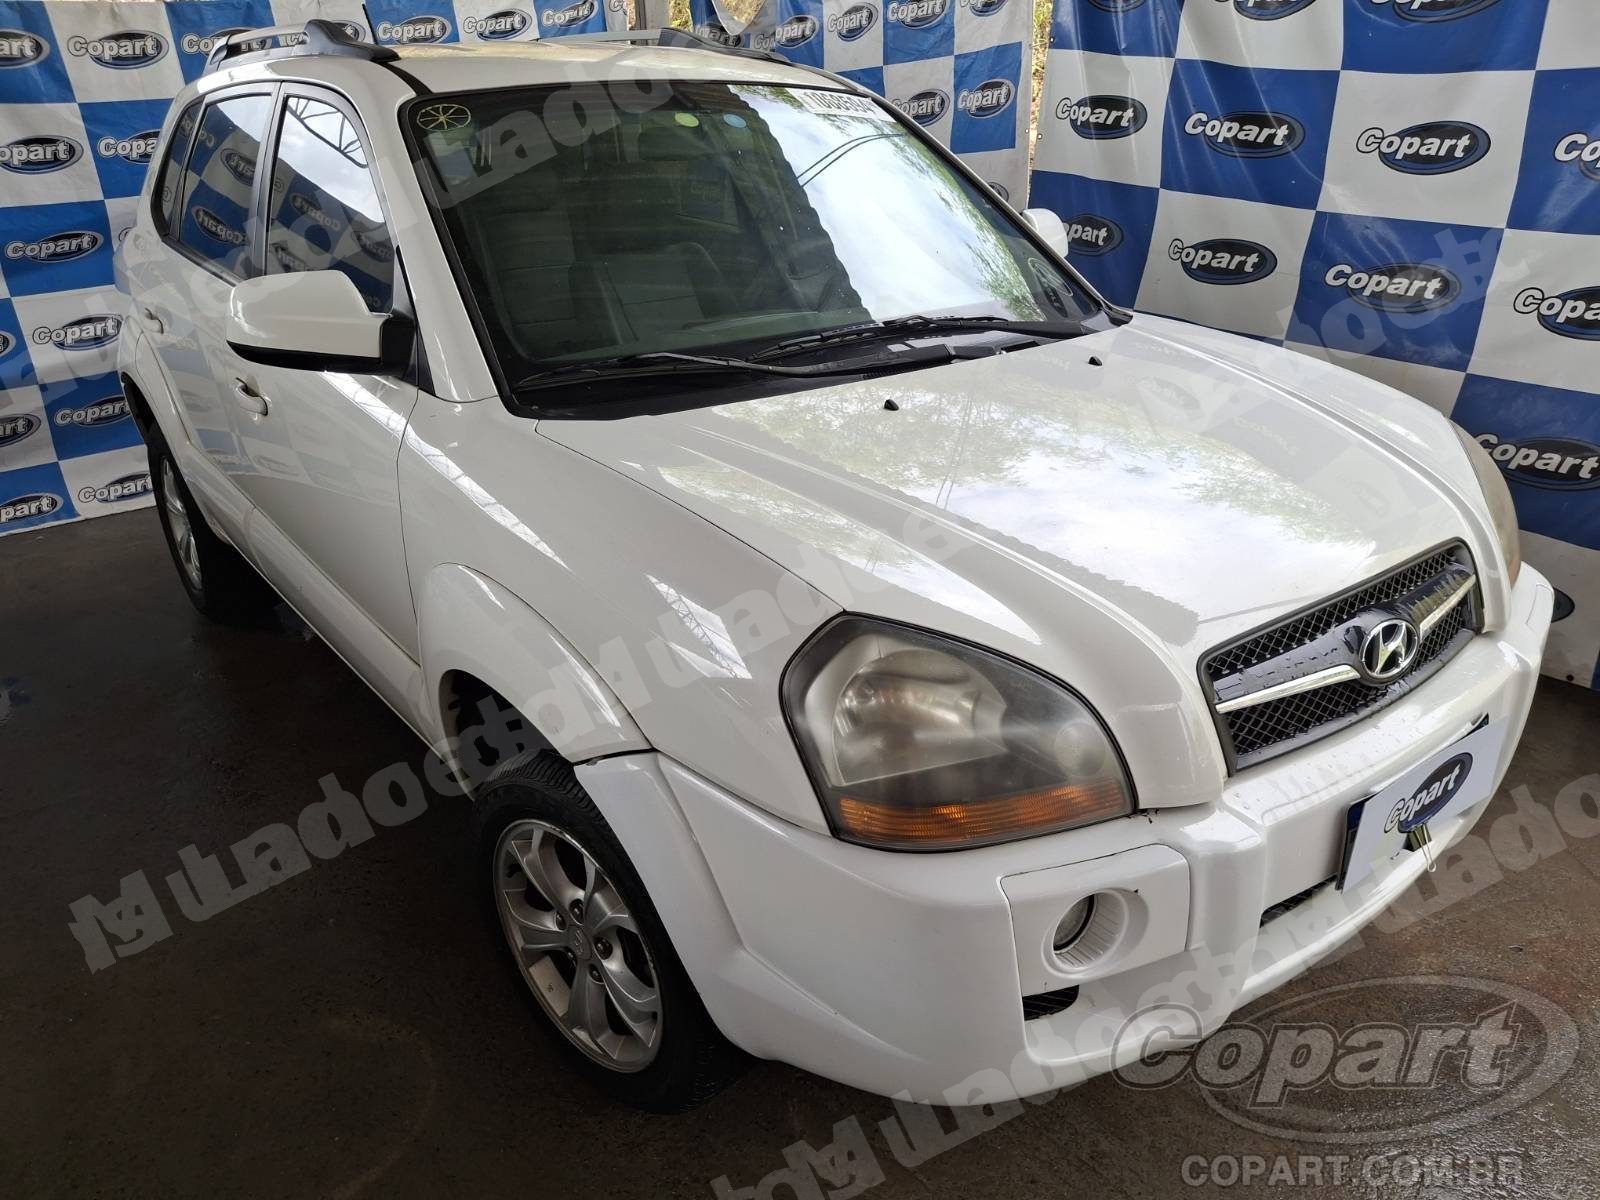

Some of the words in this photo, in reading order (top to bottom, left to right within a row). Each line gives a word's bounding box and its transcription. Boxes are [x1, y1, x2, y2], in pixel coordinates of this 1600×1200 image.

[377, 17, 443, 43] Copart
[463, 12, 525, 35] Copart
[827, 8, 872, 33] Copart
[67, 35, 158, 62] Copart
[958, 80, 1009, 113] Copart
[1056, 97, 1135, 127] Copart
[1184, 112, 1288, 146] Copart
[1355, 127, 1470, 160] Copart
[5, 232, 97, 260] Copart
[1168, 238, 1260, 273] Copart
[1325, 264, 1444, 300] Copart
[33, 317, 117, 346] Copart
[1384, 763, 1461, 834] Copart
